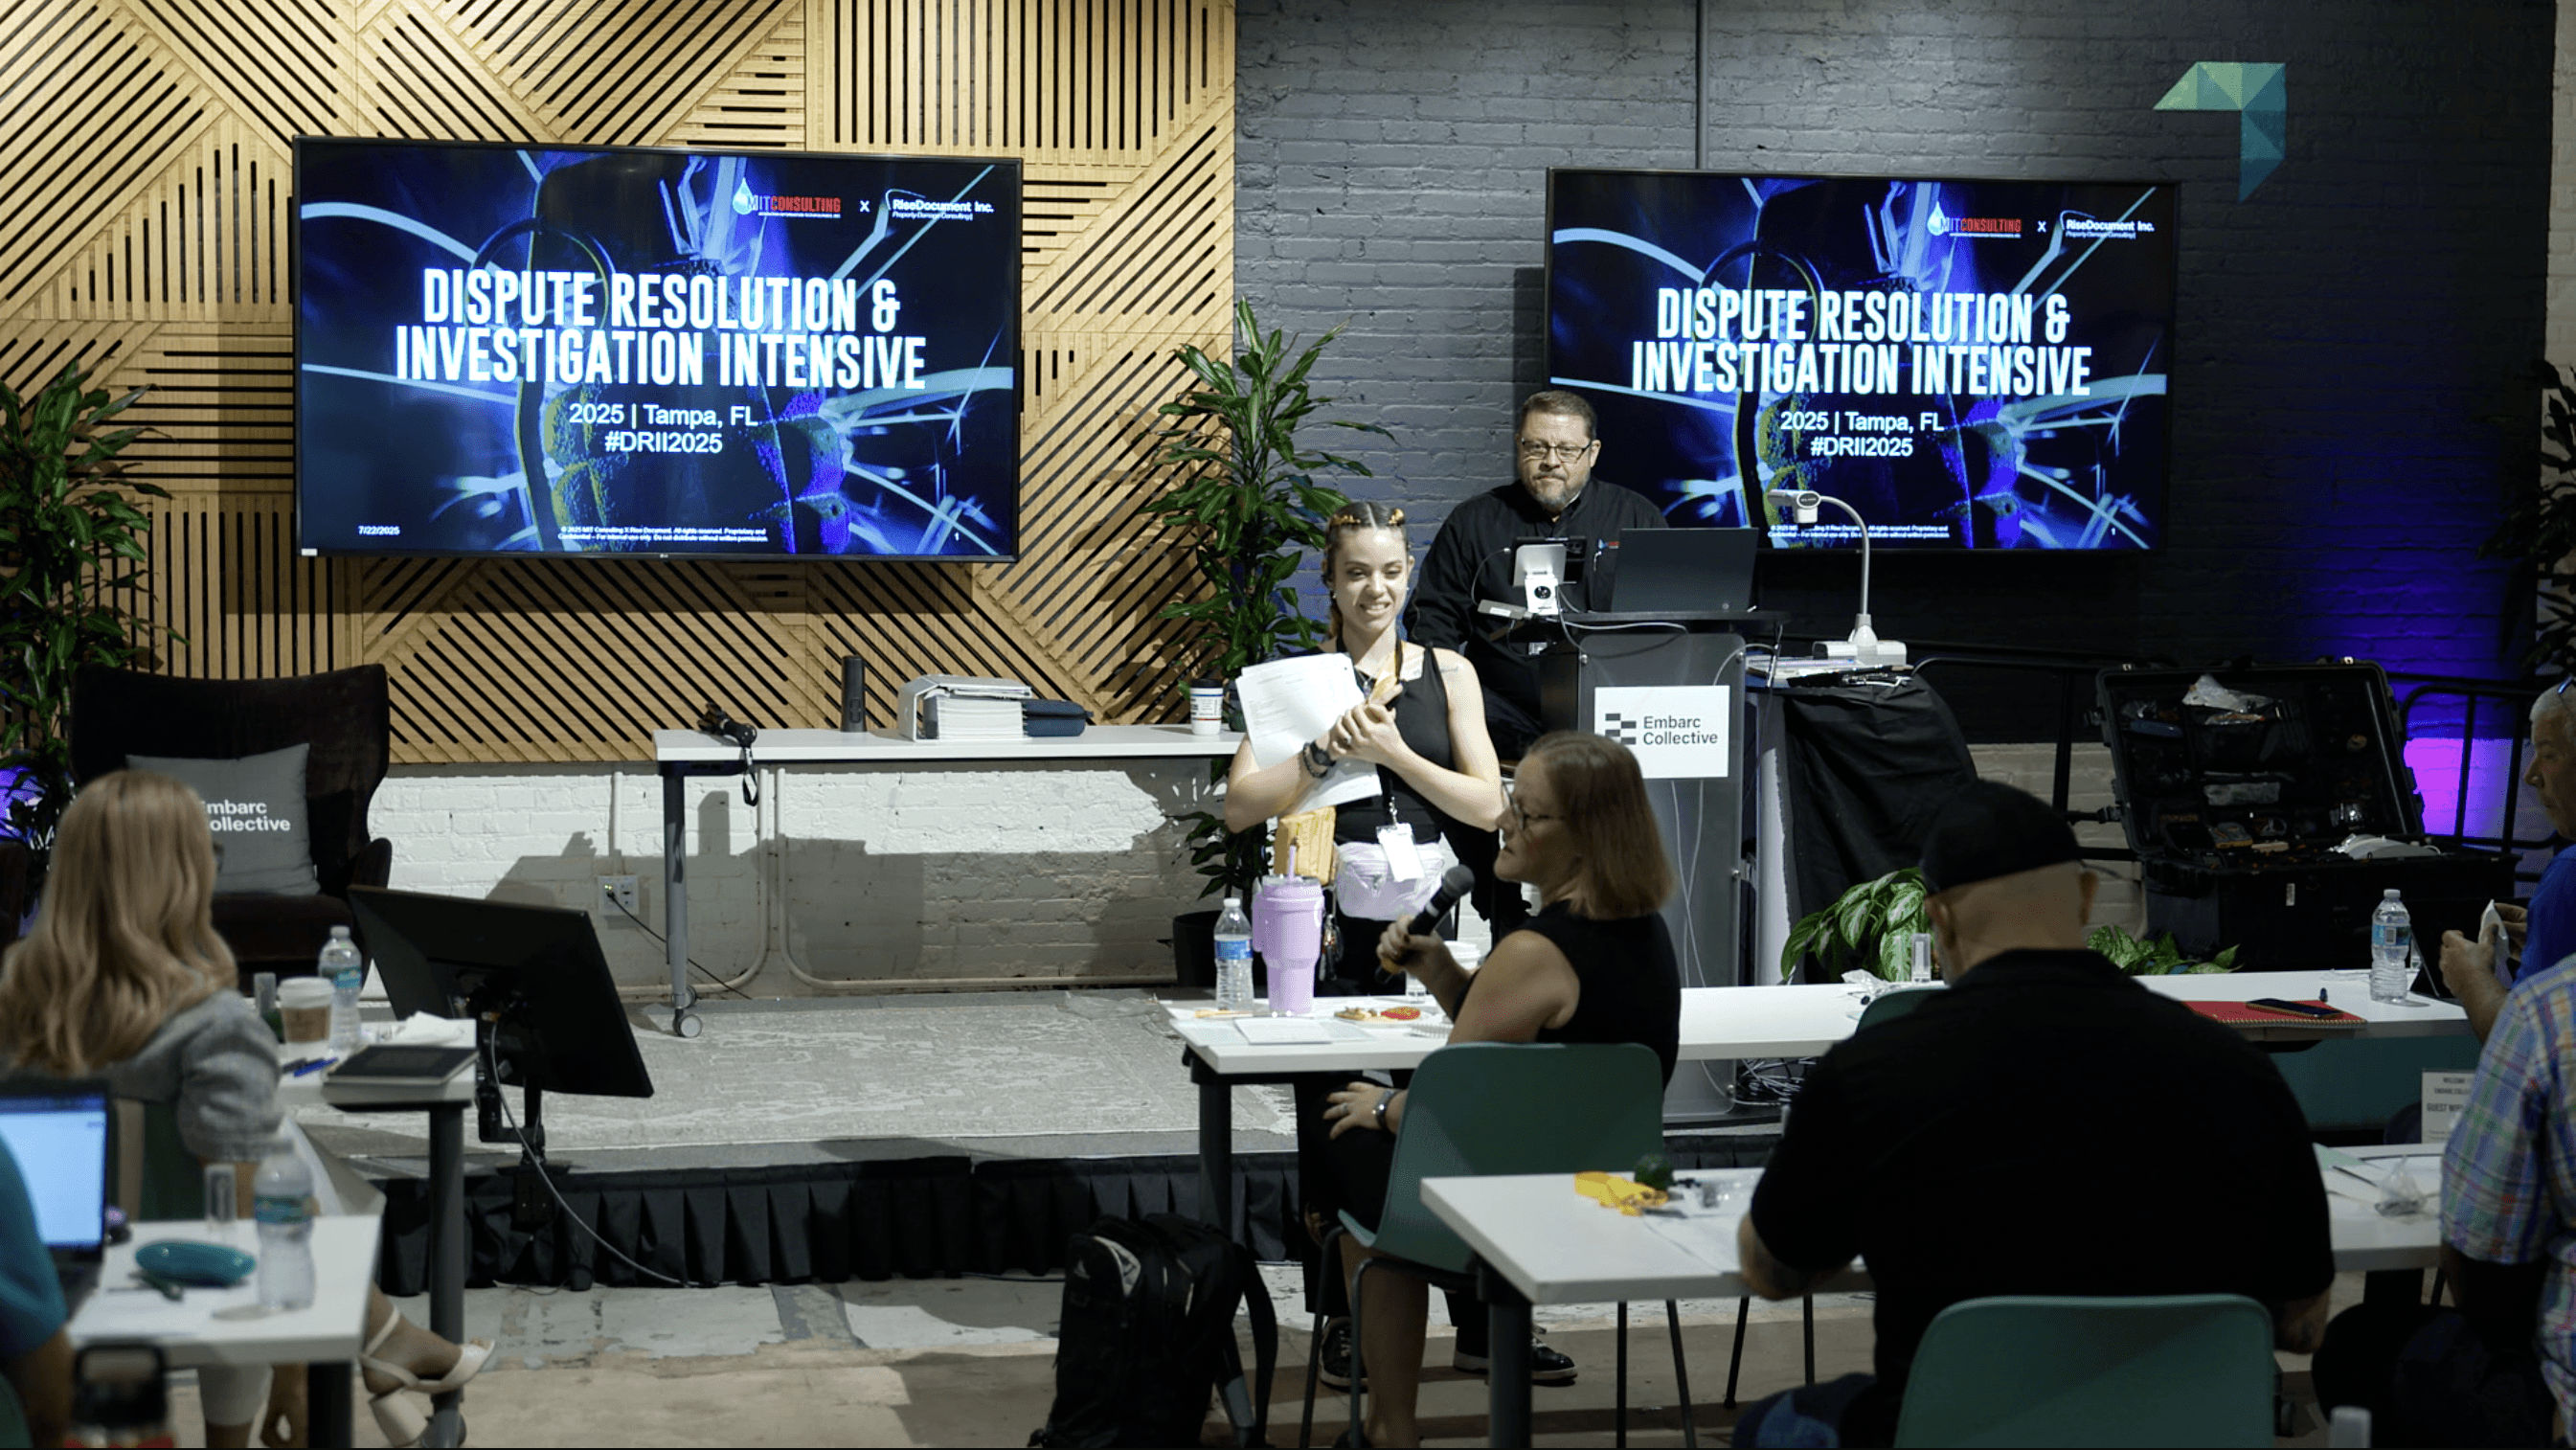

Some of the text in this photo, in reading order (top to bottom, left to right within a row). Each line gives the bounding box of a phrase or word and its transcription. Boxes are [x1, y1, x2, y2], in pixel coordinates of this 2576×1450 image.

[859, 199, 870, 213] X
[974, 201, 995, 214] Inc.
[2037, 220, 2047, 233] X
[2137, 220, 2155, 232] Inc.
[423, 267, 901, 332] DISPUTE RESOLUTION &
[1657, 287, 2071, 344] DISPUTE RESOLUTION &
[395, 325, 926, 390] INVESTIGATION INTENSIVE
[1632, 341, 2092, 396] INVESTIGATION INTENSIVE
[569, 402, 625, 424] 2025
[643, 403, 723, 430] Tampa,
[730, 405, 759, 427] FL
[1779, 411, 1829, 431] 2025
[1844, 411, 1914, 436] Tampa,
[1920, 412, 1945, 432] FL
[603, 430, 723, 454] #DRII2025
[1810, 436, 1913, 457] #DRII2025
[358, 525, 400, 535] 7/22/2025
[1642, 714, 1702, 730] Embarc
[1642, 731, 1718, 745] Collective
[202, 799, 267, 815] mbarc
[210, 815, 291, 831] ollective
